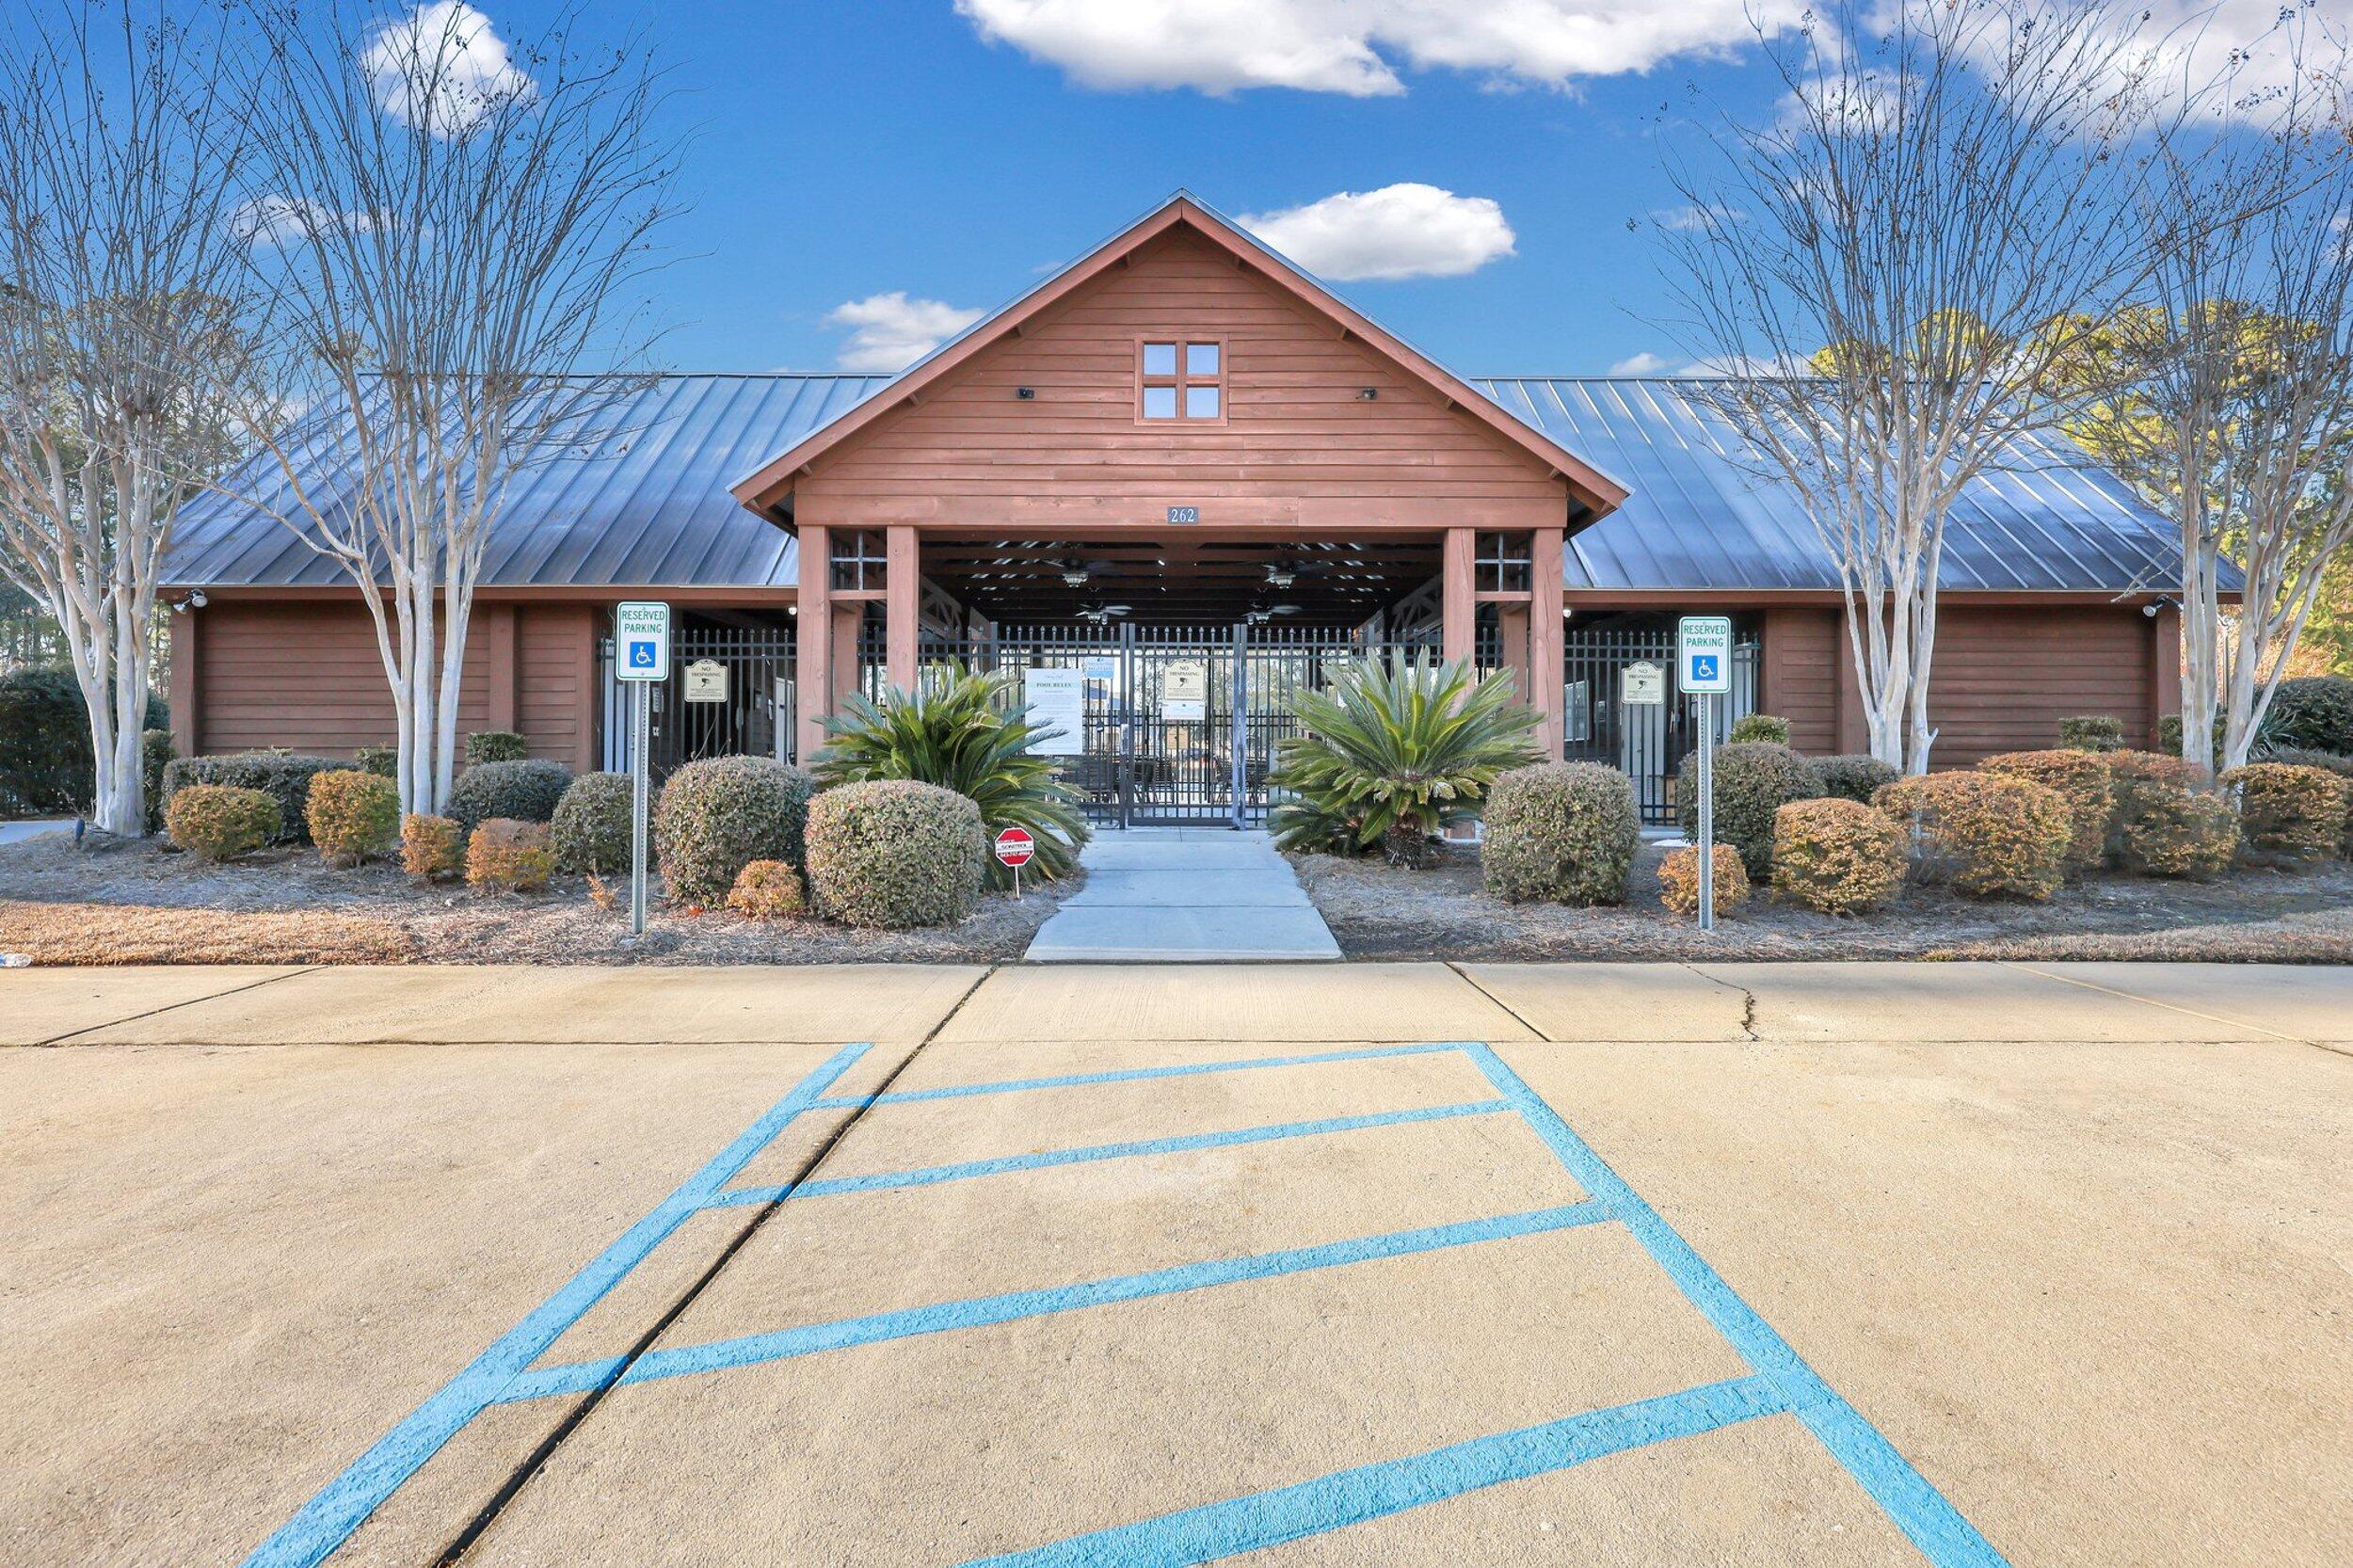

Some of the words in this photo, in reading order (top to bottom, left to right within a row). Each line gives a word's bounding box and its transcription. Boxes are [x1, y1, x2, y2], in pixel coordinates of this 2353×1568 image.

[1171, 508, 1194, 522] 262
[621, 610, 665, 620] RESERVED
[624, 623, 663, 633] PARKING
[1683, 625, 1727, 634] RESERVED
[1686, 637, 1724, 648] PARKING
